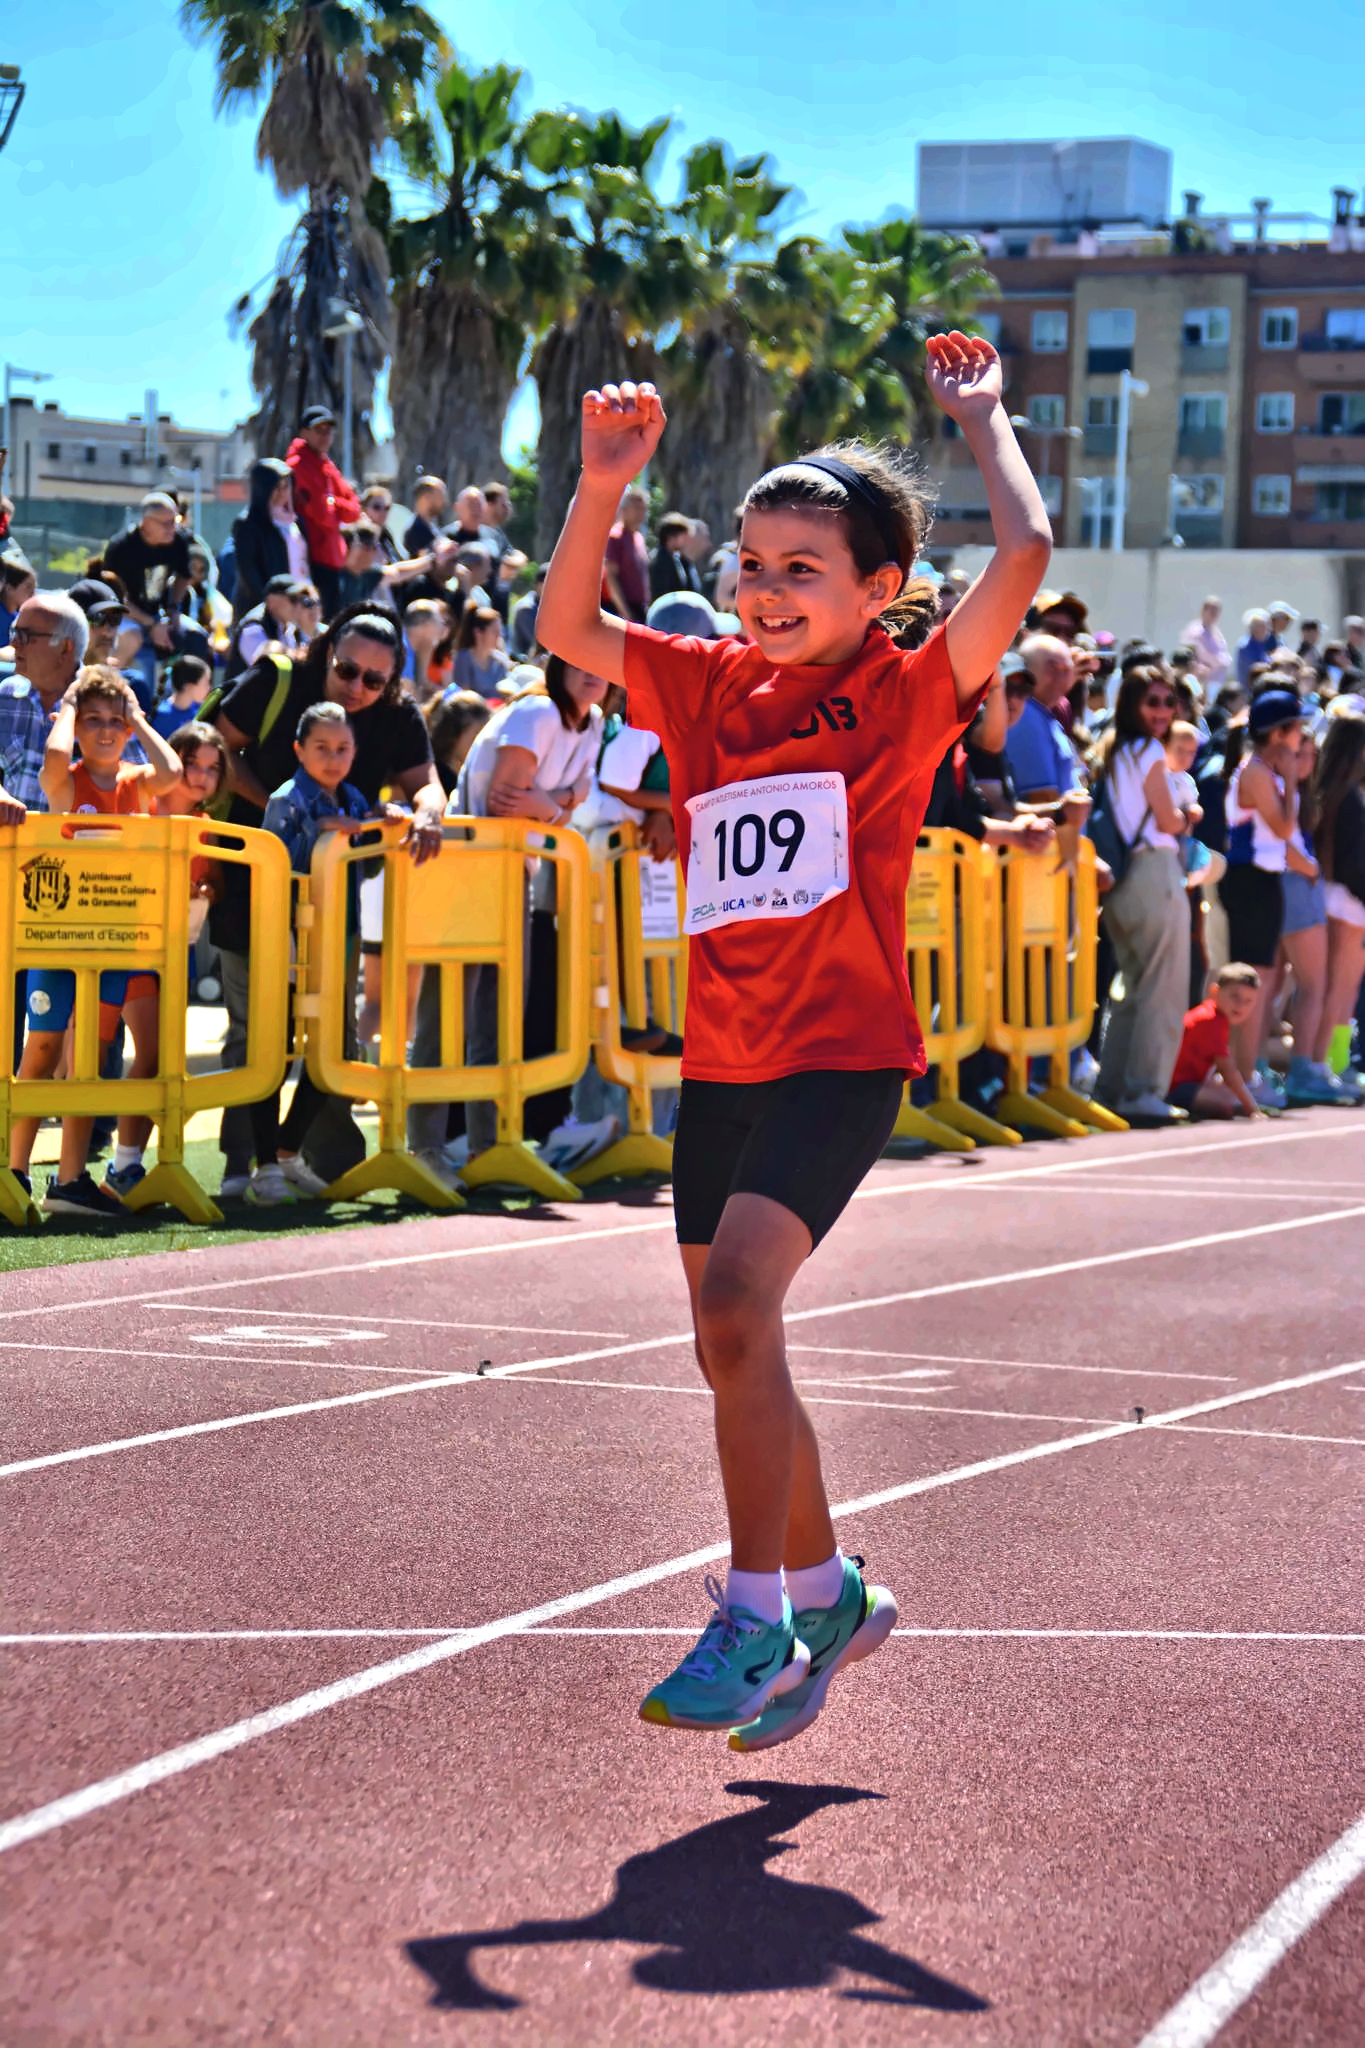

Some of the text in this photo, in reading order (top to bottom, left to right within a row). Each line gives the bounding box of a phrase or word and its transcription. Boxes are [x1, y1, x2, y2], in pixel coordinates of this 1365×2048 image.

[750, 783, 790, 797] ANTONIO
[714, 809, 805, 882] 109
[79, 871, 132, 882] Ajuntament
[78, 884, 156, 896] de Santa Coloma
[78, 898, 137, 908] de Gramenet
[722, 897, 745, 912] UCA
[25, 928, 150, 943] Departament d'Esports
